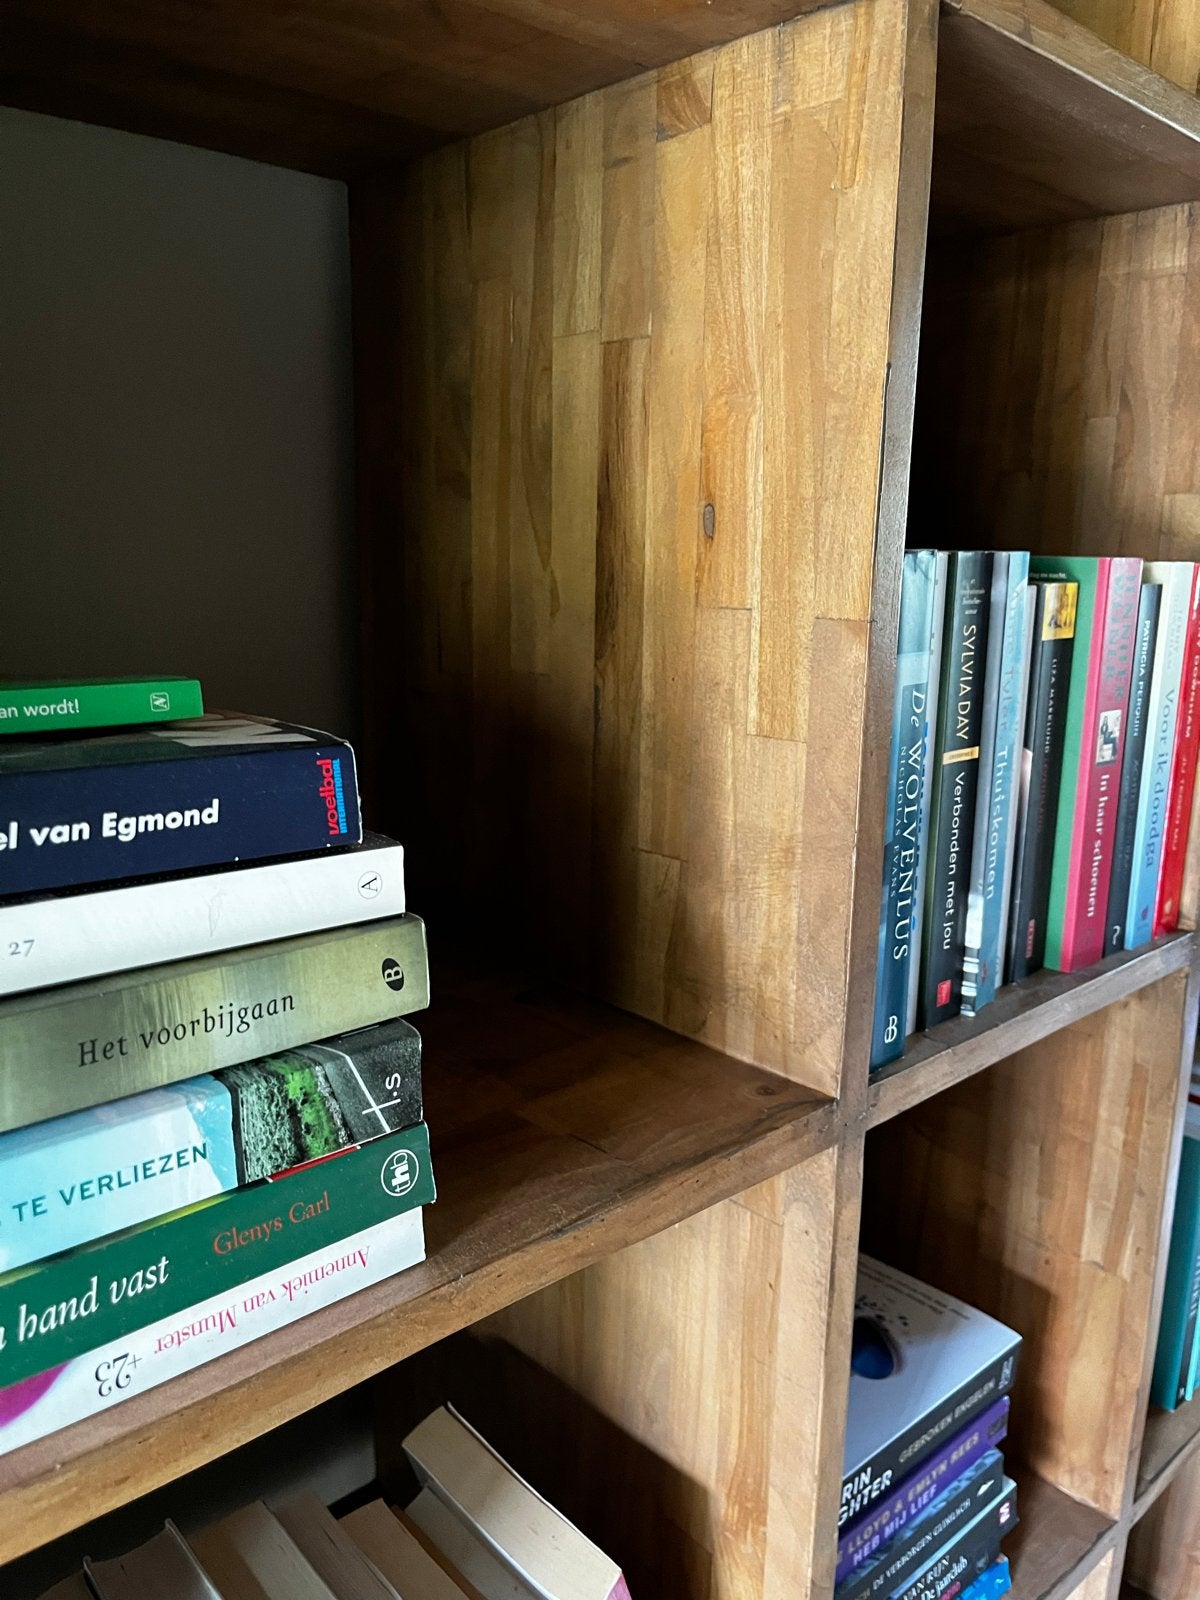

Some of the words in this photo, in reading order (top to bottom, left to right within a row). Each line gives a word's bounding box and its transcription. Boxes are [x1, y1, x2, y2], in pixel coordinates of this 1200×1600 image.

[958, 625, 977, 697] SYLVIA
[1138, 620, 1151, 677] PATRICIA
[23, 698, 80, 717] wordt!
[910, 688, 926, 728] De
[955, 700, 972, 740] DAY
[1132, 681, 1145, 737] PERQUIN
[1160, 688, 1176, 746] Voor
[1099, 774, 1111, 792] In
[1155, 751, 1169, 774] ik
[316, 758, 340, 835] voetbal
[894, 746, 907, 836] NICHOLAS
[1095, 795, 1109, 836] haar
[29, 821, 91, 847] van
[102, 798, 220, 842] Egmond
[893, 738, 923, 960] WOLVENLUS
[947, 771, 966, 876] Verbonden
[986, 745, 1009, 901] Thuiskomen
[1146, 781, 1165, 868] doodga
[361, 876, 378, 893] A
[889, 844, 900, 898] EVANS
[945, 881, 956, 916] met
[1087, 839, 1103, 918] schoenen
[8, 939, 35, 957] 27
[943, 920, 954, 950] jou
[384, 965, 403, 983] B
[78, 1035, 128, 1067] Het
[140, 994, 296, 1049] voorbijgaan
[12, 1194, 48, 1223] TE
[59, 1142, 209, 1207] VERLIEZEN
[213, 1216, 283, 1255] Glenys
[288, 1191, 331, 1225] Carl
[18, 1275, 100, 1342] hand
[109, 1256, 170, 1305] vast
[243, 1289, 276, 1314] van
[281, 1245, 371, 1302] Annemiek
[154, 1304, 238, 1354] Munster
[898, 1412, 953, 1463] GEBROKEN
[848, 1510, 891, 1551] LLOYD
[906, 1459, 949, 1503] EMLYN
[950, 1431, 981, 1465] REES
[852, 1536, 881, 1567] HEB
[883, 1511, 909, 1541] MIJ
[910, 1483, 939, 1516] LIEF
[885, 1532, 933, 1578] VERBORGEN
